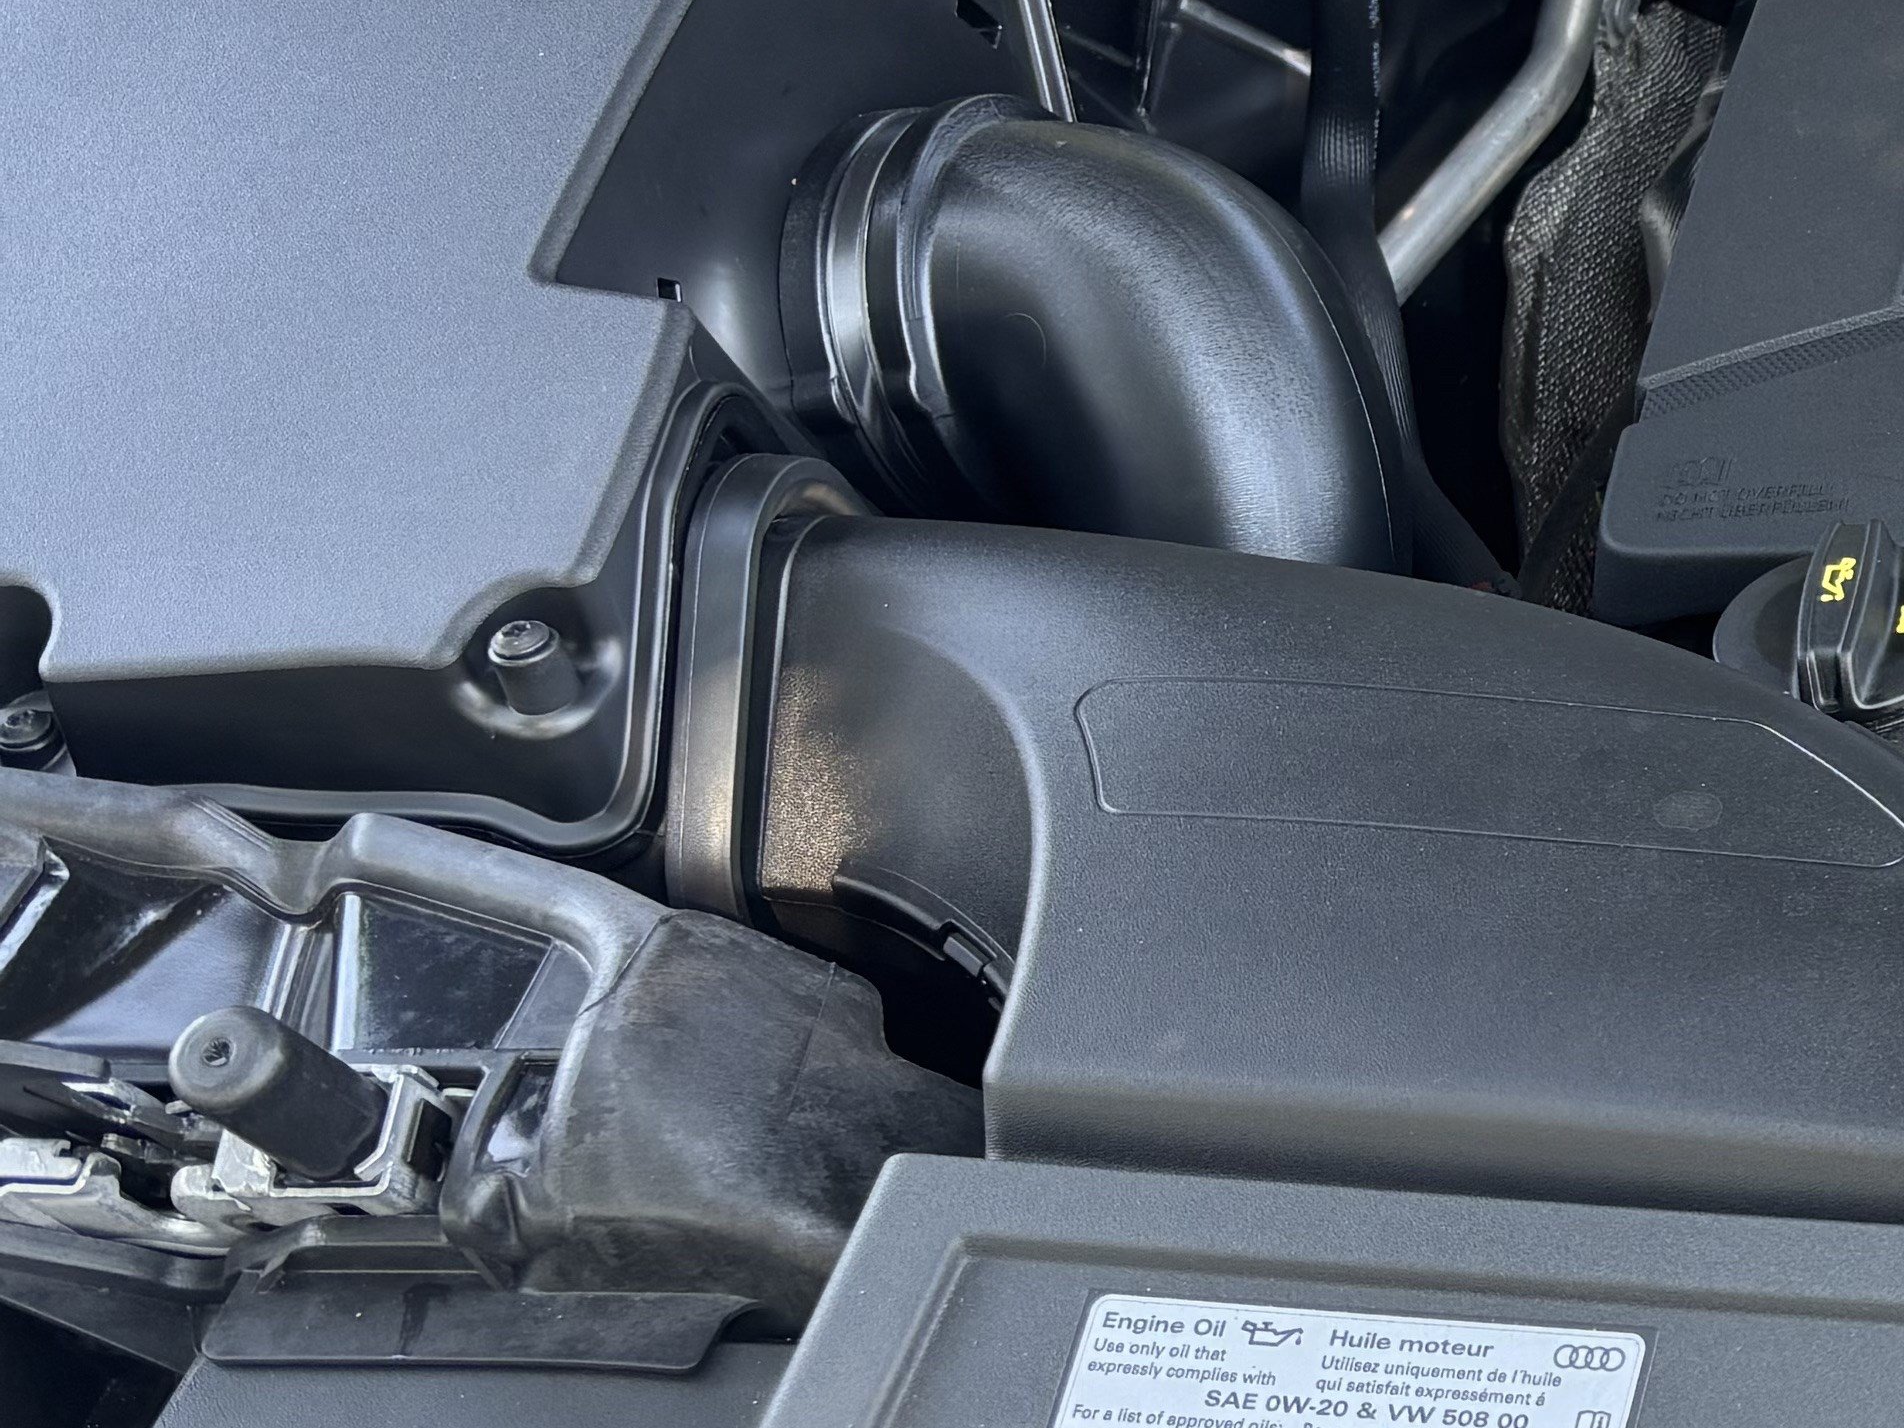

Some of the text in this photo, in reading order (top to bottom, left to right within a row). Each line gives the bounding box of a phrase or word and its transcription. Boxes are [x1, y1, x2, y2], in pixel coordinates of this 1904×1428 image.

[1101, 1310, 1226, 1337] Engine Oil
[1093, 1336, 1227, 1362] Use only oil that
[1328, 1328, 1494, 1358] Huile moteur
[1086, 1360, 1276, 1386] expressly complies with
[1320, 1354, 1380, 1373] Utilisez
[1383, 1361, 1483, 1382] uniquement
[1486, 1367, 1507, 1383] de
[1315, 1376, 1343, 1393] qui
[1345, 1379, 1411, 1397] satisfait
[1414, 1385, 1531, 1406] expressément
[1071, 1403, 1100, 1420] For
[1102, 1409, 1113, 1421] a
[1116, 1407, 1142, 1423] list
[1145, 1410, 1165, 1425] of
[1203, 1389, 1258, 1410] SAE
[1264, 1394, 1348, 1417] 0W-20
[1355, 1401, 1377, 1419] &
[1388, 1403, 1436, 1424] VW
[1441, 1408, 1489, 1428] 508
